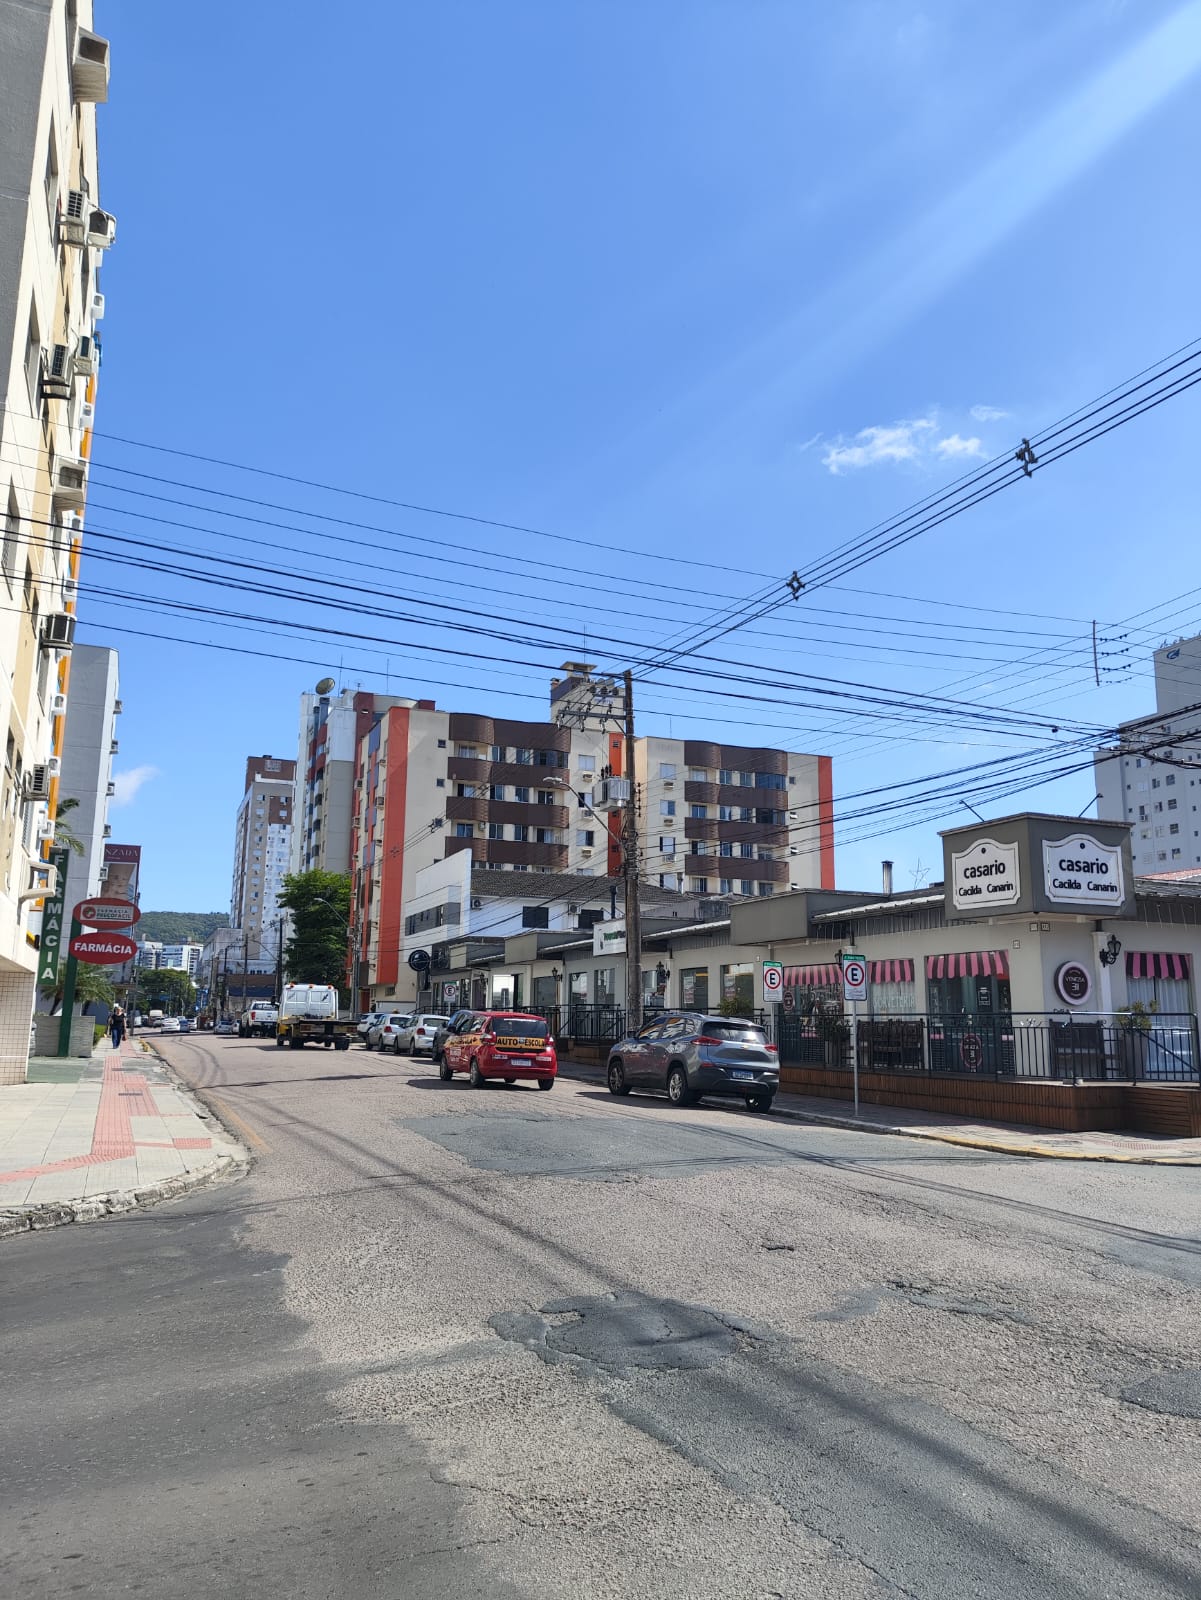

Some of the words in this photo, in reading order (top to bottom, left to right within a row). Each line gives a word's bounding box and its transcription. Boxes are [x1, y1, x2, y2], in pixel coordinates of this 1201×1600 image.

[963, 859, 1006, 879] casario
[1058, 857, 1109, 875] casario
[1052, 878, 1082, 891] Cacilda
[958, 885, 983, 897] Cacilda
[74, 942, 132, 954] FARMÁCIA
[769, 973, 776, 985] E
[851, 968, 859, 982] E
[497, 1037, 518, 1046] AUTO
